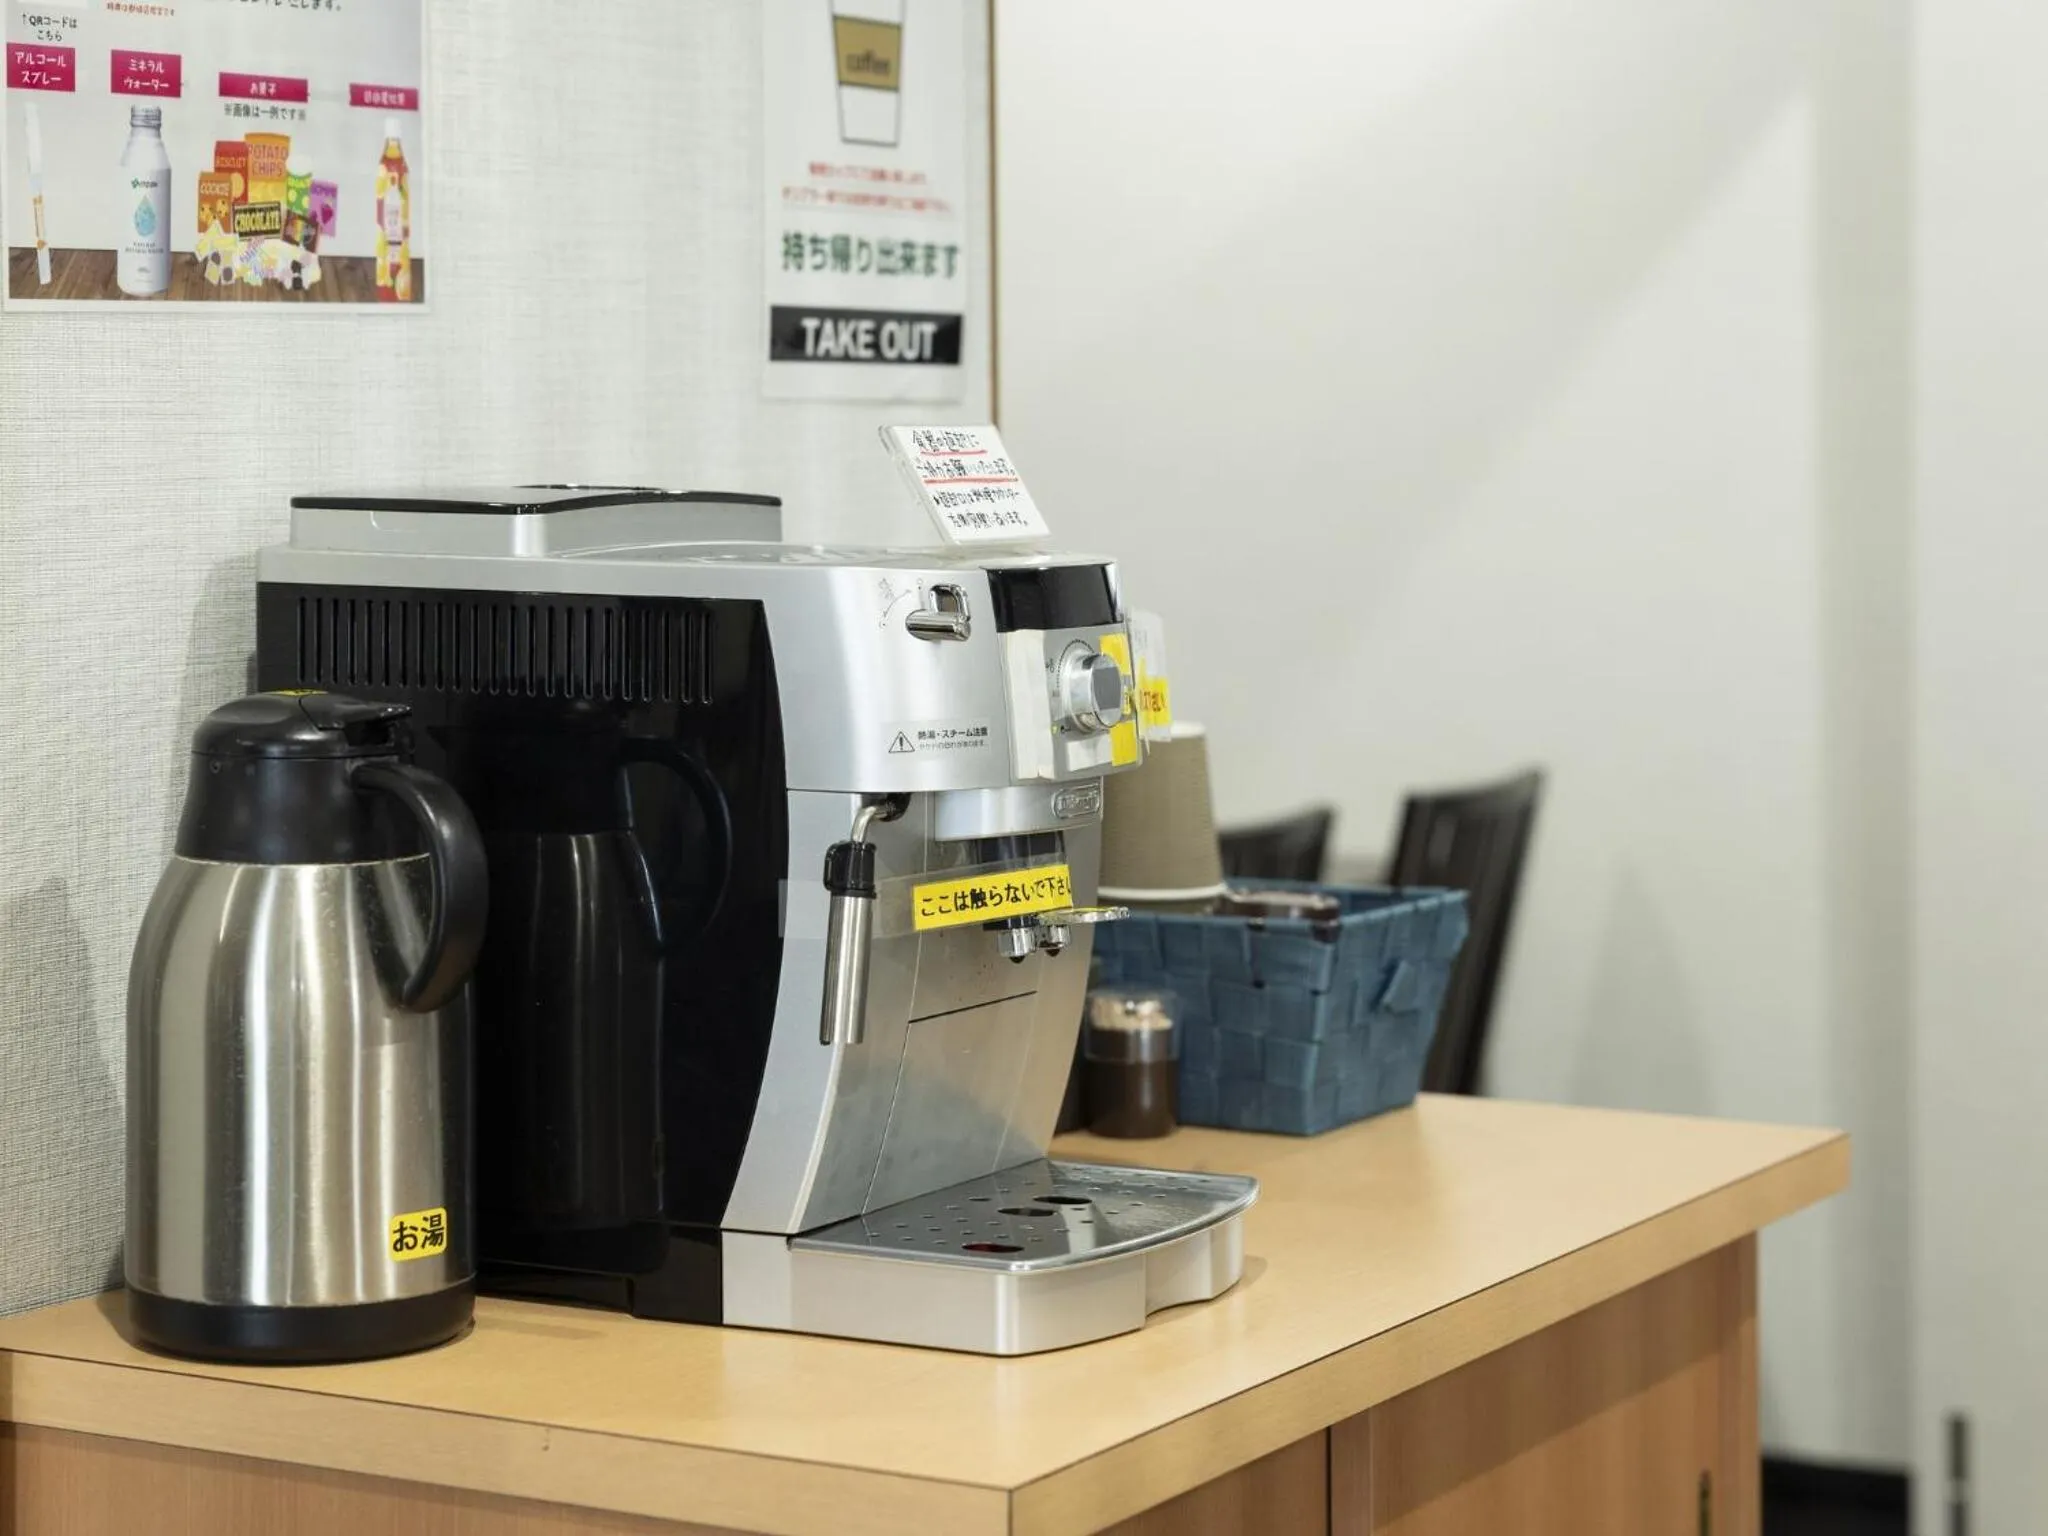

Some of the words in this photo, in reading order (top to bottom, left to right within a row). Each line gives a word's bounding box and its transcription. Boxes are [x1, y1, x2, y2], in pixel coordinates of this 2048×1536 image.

[37, 29, 63, 42] こちら
[15, 51, 67, 68] アルコール
[128, 58, 165, 74] ミネラル
[21, 70, 62, 86] スプレー
[123, 77, 171, 92] ウォーター
[252, 160, 286, 177] CHIPS
[235, 210, 282, 233] CHOCOLATE
[782, 229, 960, 280] 持ち帰り出来ます
[801, 316, 876, 359] TAKE
[879, 319, 938, 361] OUT
[392, 1213, 444, 1252] お湯
